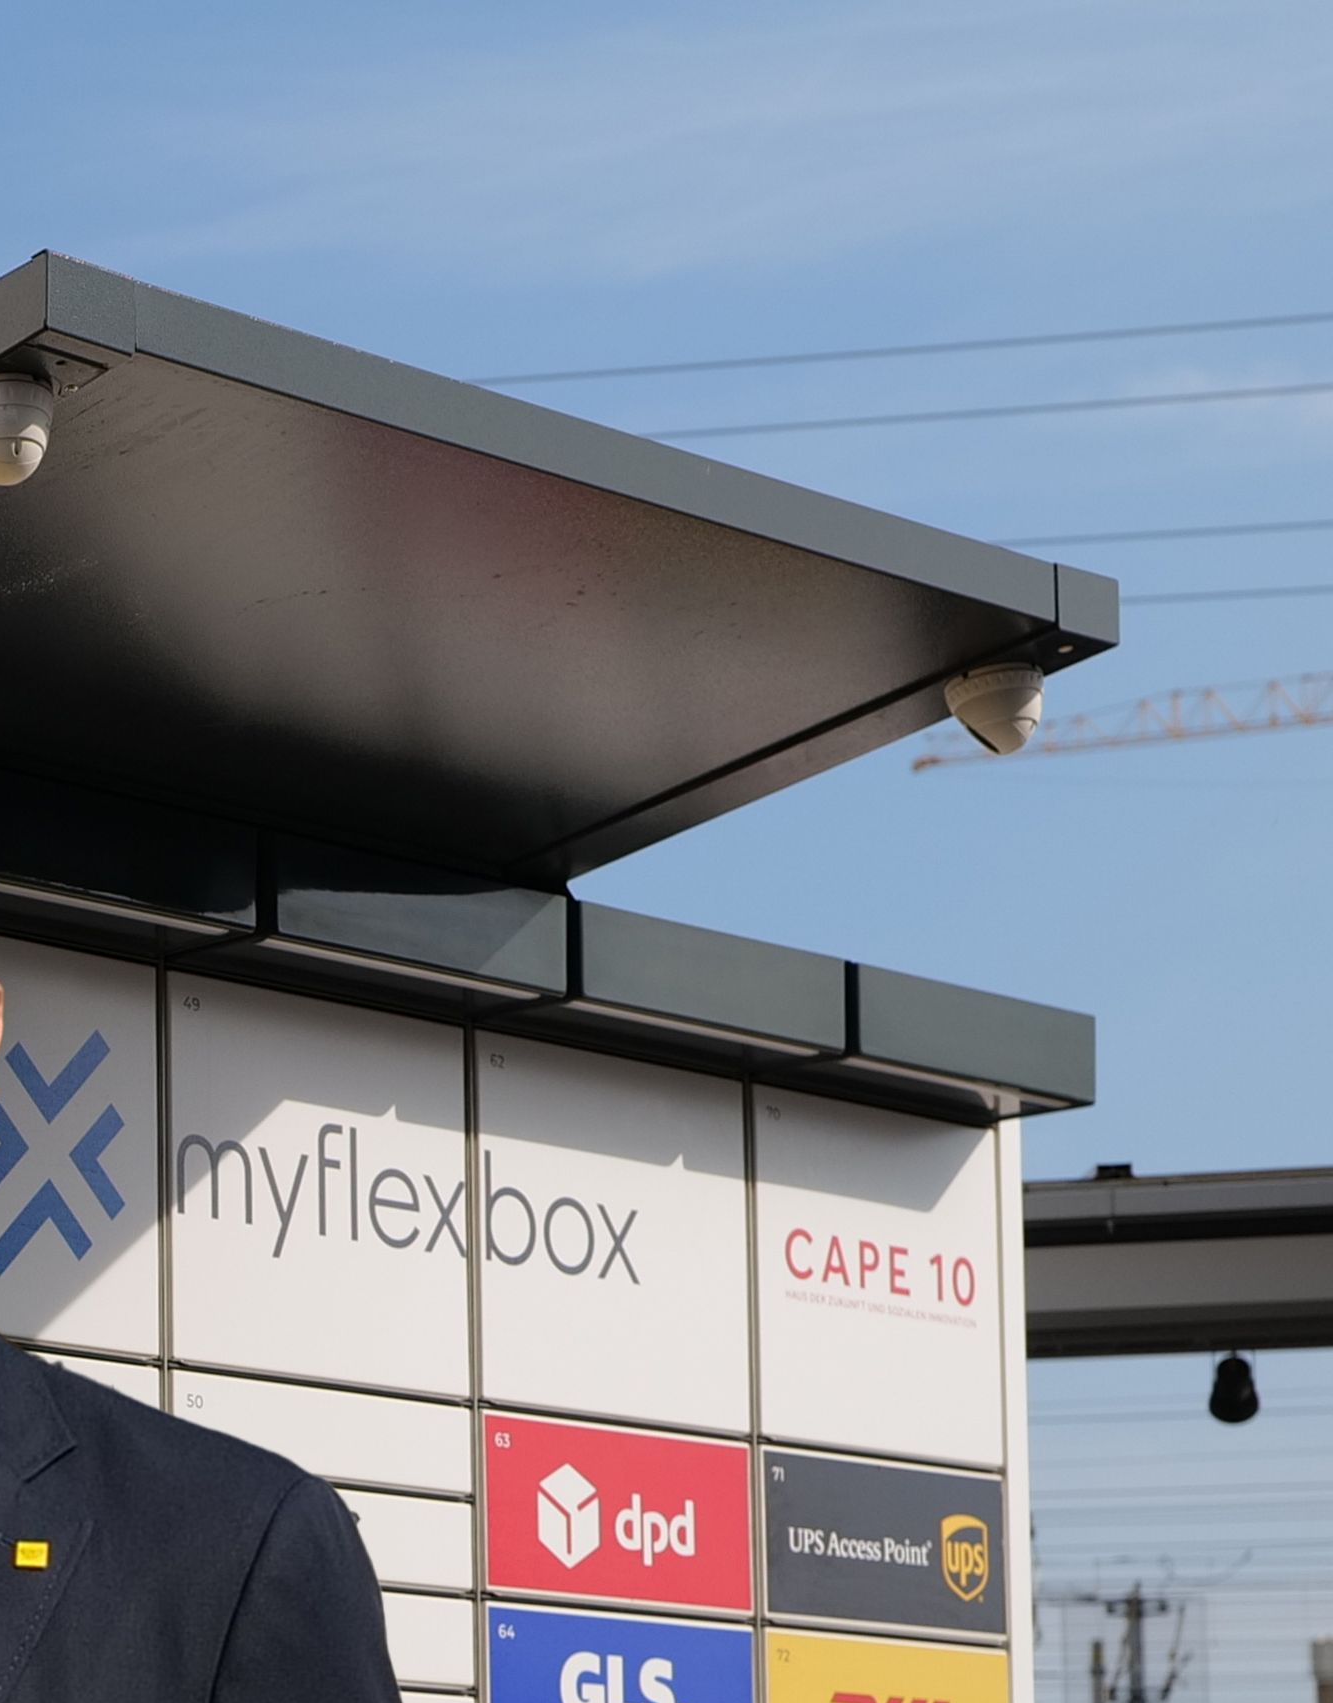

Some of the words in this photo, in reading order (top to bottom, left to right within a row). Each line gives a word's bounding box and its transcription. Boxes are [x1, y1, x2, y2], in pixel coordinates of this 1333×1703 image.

[183, 996, 201, 1012] 49
[490, 1053, 506, 1069] 62
[785, 1229, 910, 1296] CAPE
[930, 1254, 975, 1306] 10
[187, 1394, 203, 1409] 50
[495, 1432, 510, 1448] 63
[772, 1466, 785, 1482] 71
[615, 1494, 695, 1566] dpd
[789, 1527, 824, 1555] UPS
[827, 1532, 881, 1561] Access
[947, 1540, 984, 1586] ups
[498, 1624, 515, 1638] 64
[777, 1648, 790, 1662] 72
